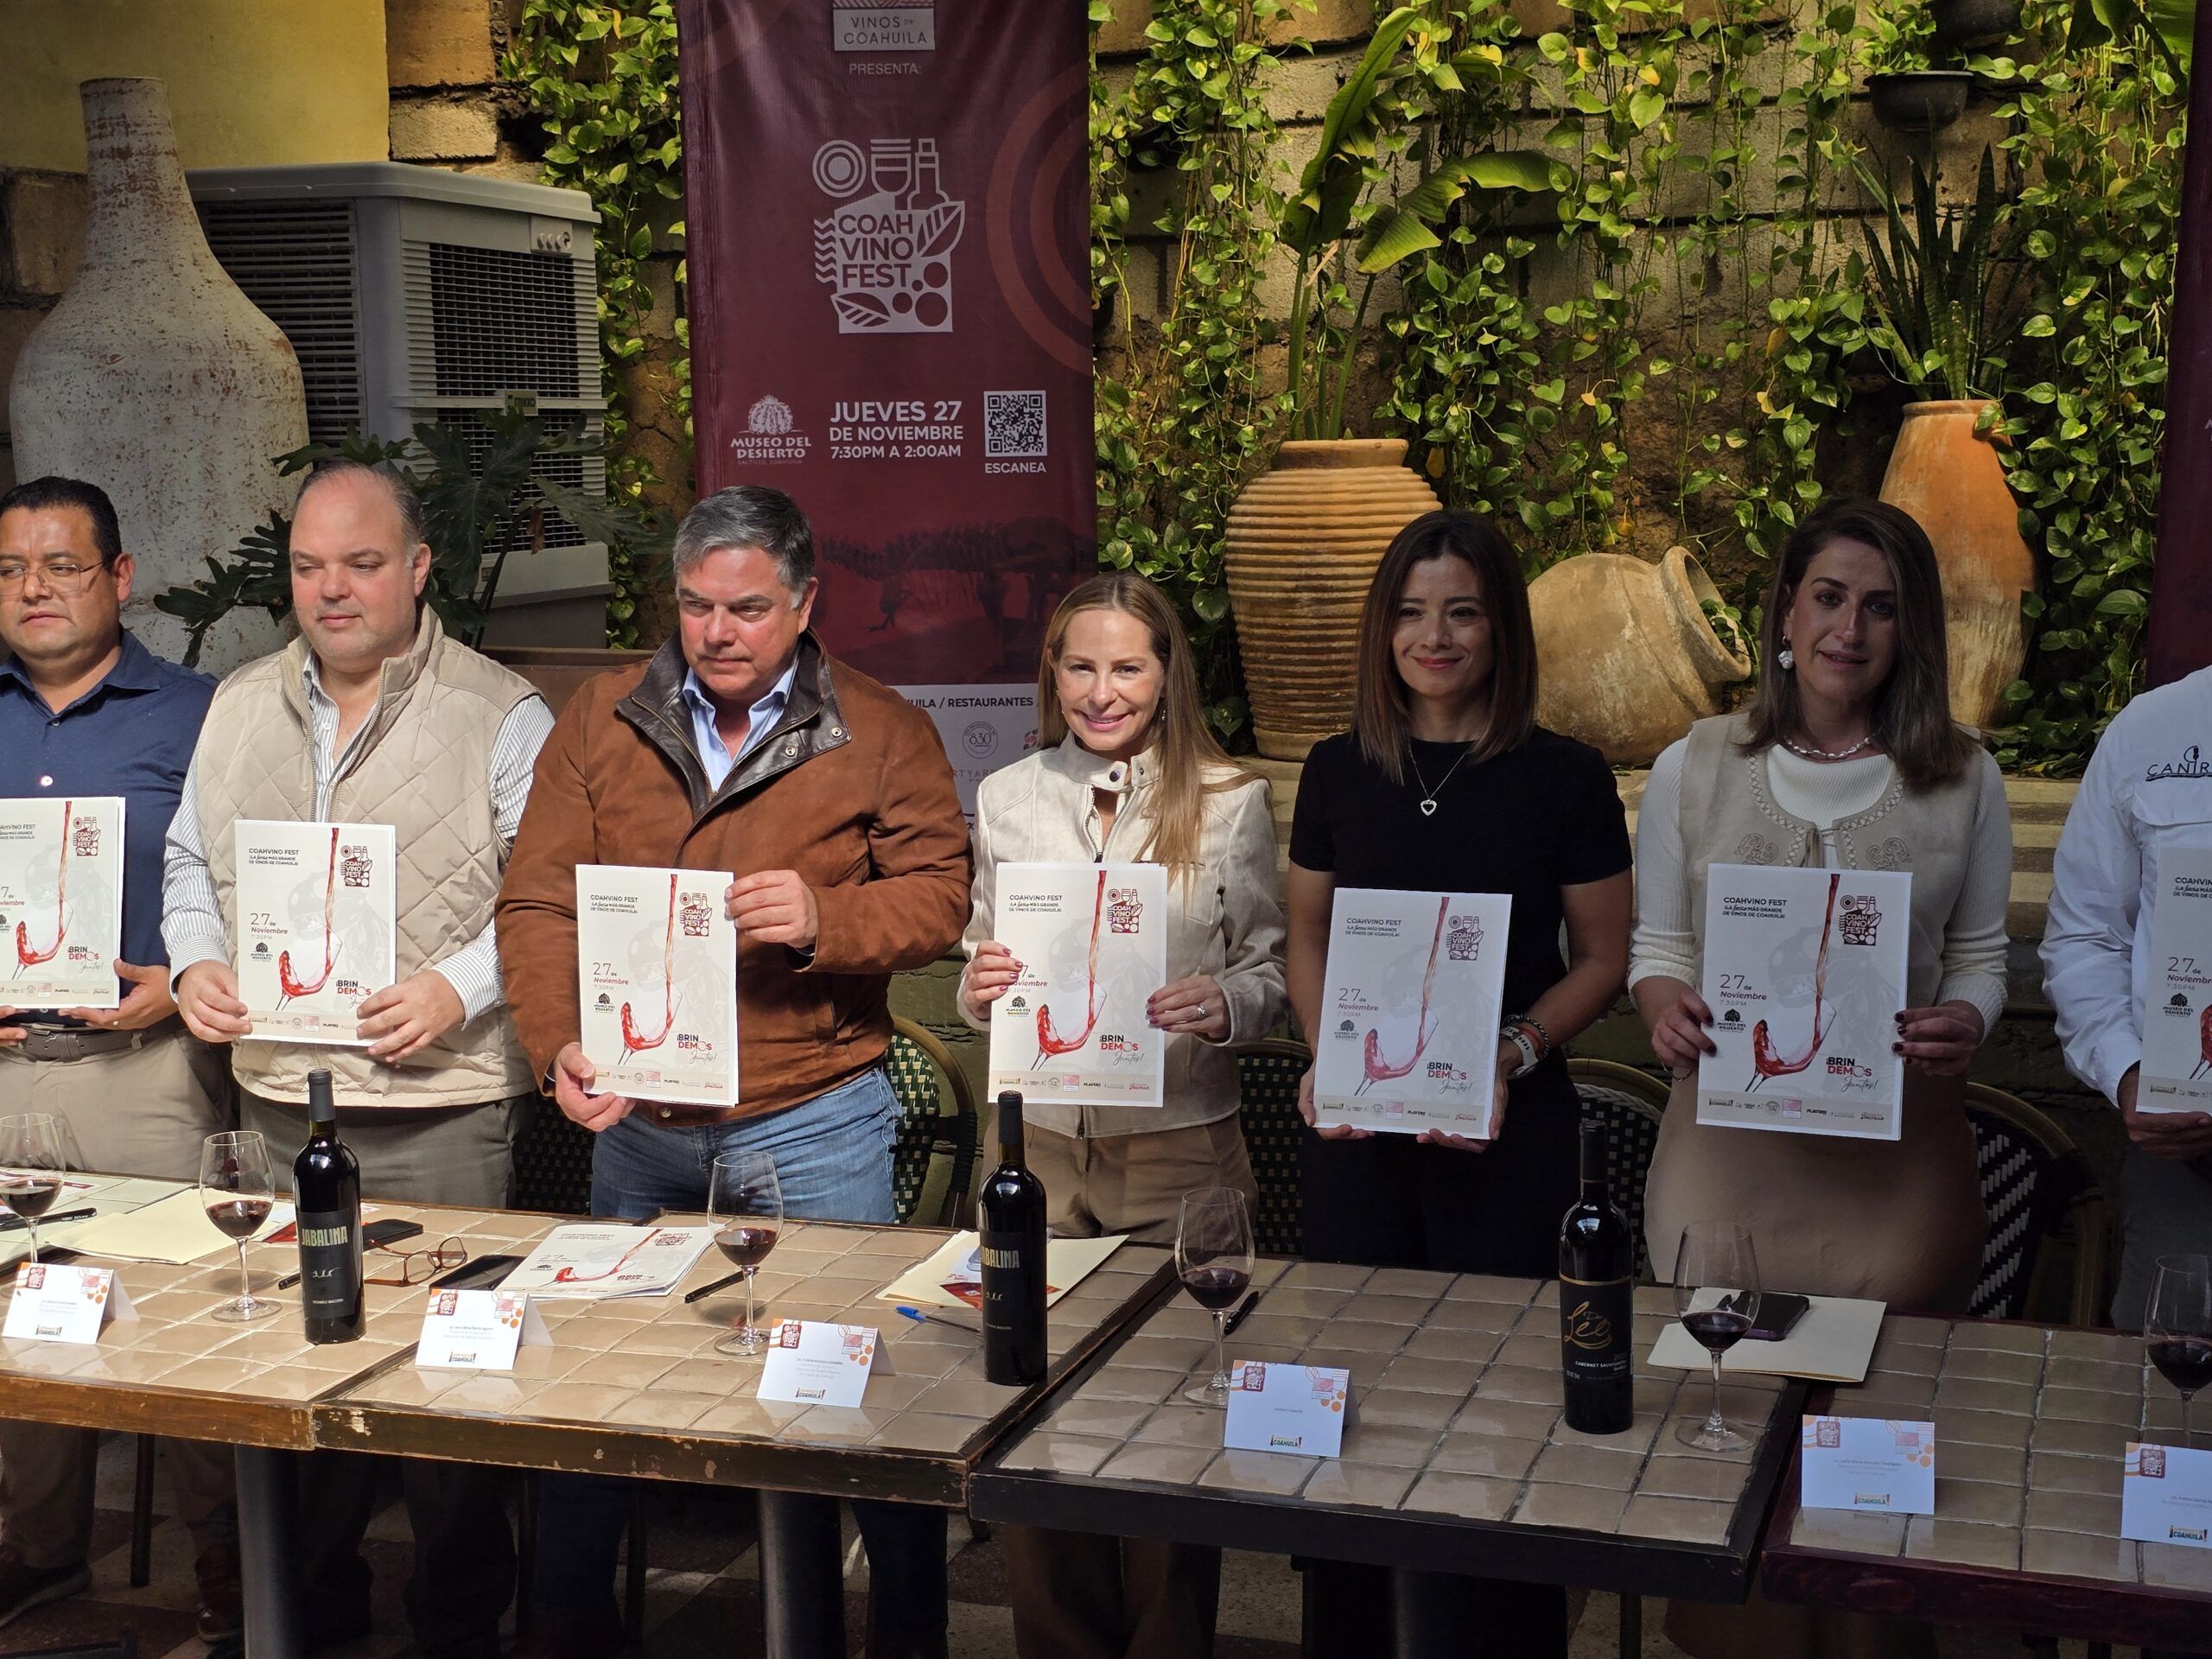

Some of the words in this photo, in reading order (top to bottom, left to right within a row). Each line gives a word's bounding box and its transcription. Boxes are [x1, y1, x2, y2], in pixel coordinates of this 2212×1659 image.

[851, 16, 900, 29] VINOS
[843, 31, 927, 45] COAHUILA
[849, 63, 922, 75] PRESENTA:
[838, 214, 913, 235] COAH
[842, 238, 913, 260] VINO
[842, 264, 912, 288] FEST
[830, 401, 925, 423] JUEVES
[933, 400, 963, 422] 27
[830, 427, 853, 442] DE
[858, 425, 963, 442] NOVIEMBRE
[730, 436, 784, 448] MUSEO
[786, 436, 811, 448] DEL
[736, 448, 806, 459] DESIERTO
[830, 446, 885, 460] 7:30PM
[889, 445, 901, 458] A
[904, 444, 962, 458] 2:00AM
[985, 462, 1046, 474] ESCANEA
[907, 698, 936, 708] UILA
[948, 696, 1033, 708] RESTAURANTES
[969, 733, 992, 745] 830
[2175, 877, 2212, 885] COAHVIN
[1, 886, 10, 898] 7
[1723, 897, 1767, 905] COAHVINO
[250, 912, 270, 925] 27
[593, 962, 611, 976] 27
[1022, 965, 1029, 978] 7
[2167, 957, 2194, 973] 27
[1720, 974, 1745, 989] 27
[337, 987, 372, 996] DEMOS
[1338, 988, 1361, 1001] 27
[678, 1041, 712, 1051] DEMOS
[1101, 1041, 1139, 1052] DEMOS
[1428, 1069, 1467, 1081] DEMOS
[1827, 1065, 1872, 1078] DEMOS
[301, 1226, 348, 1247] JABALINA
[982, 1246, 1020, 1269] BALINA
